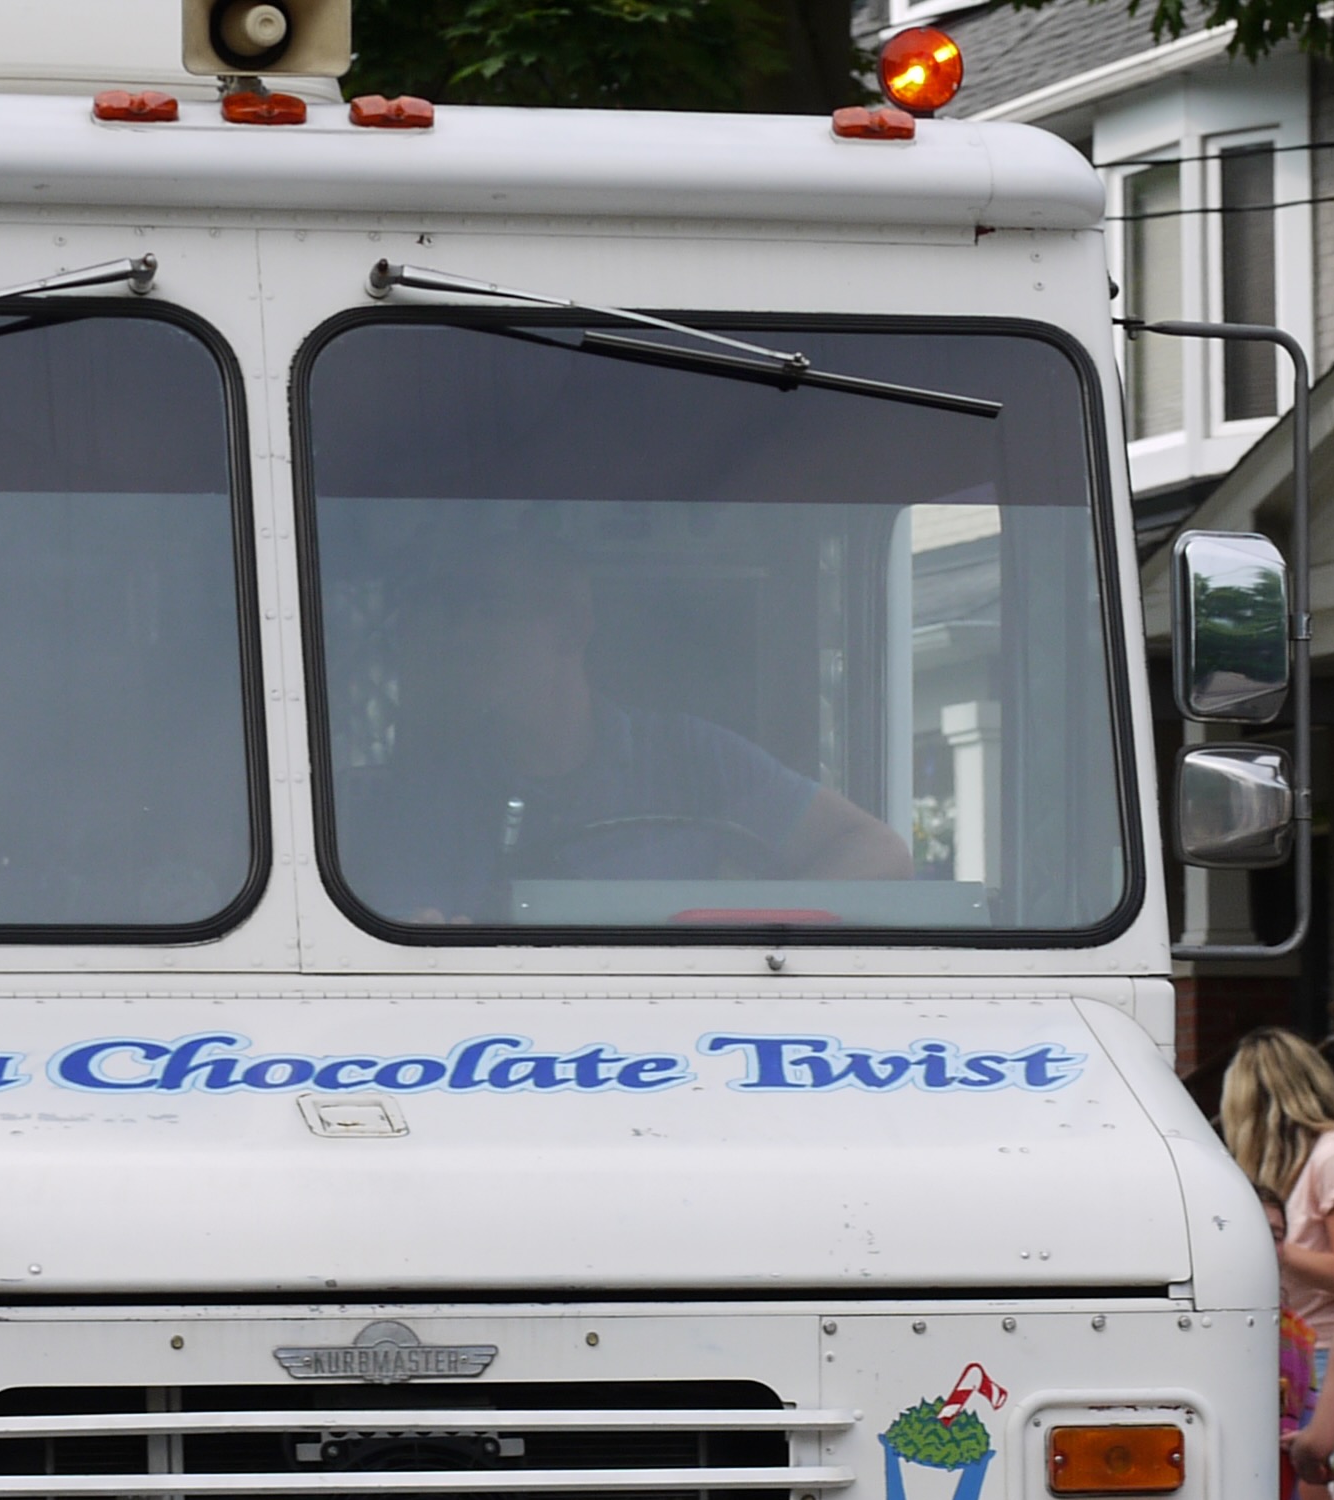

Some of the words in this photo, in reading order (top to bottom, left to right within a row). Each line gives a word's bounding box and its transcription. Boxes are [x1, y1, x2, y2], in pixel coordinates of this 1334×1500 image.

[57, 1035, 681, 1091] Chocolate
[707, 1036, 1073, 1090] Twist
[313, 1349, 460, 1375] KURBMASTER
